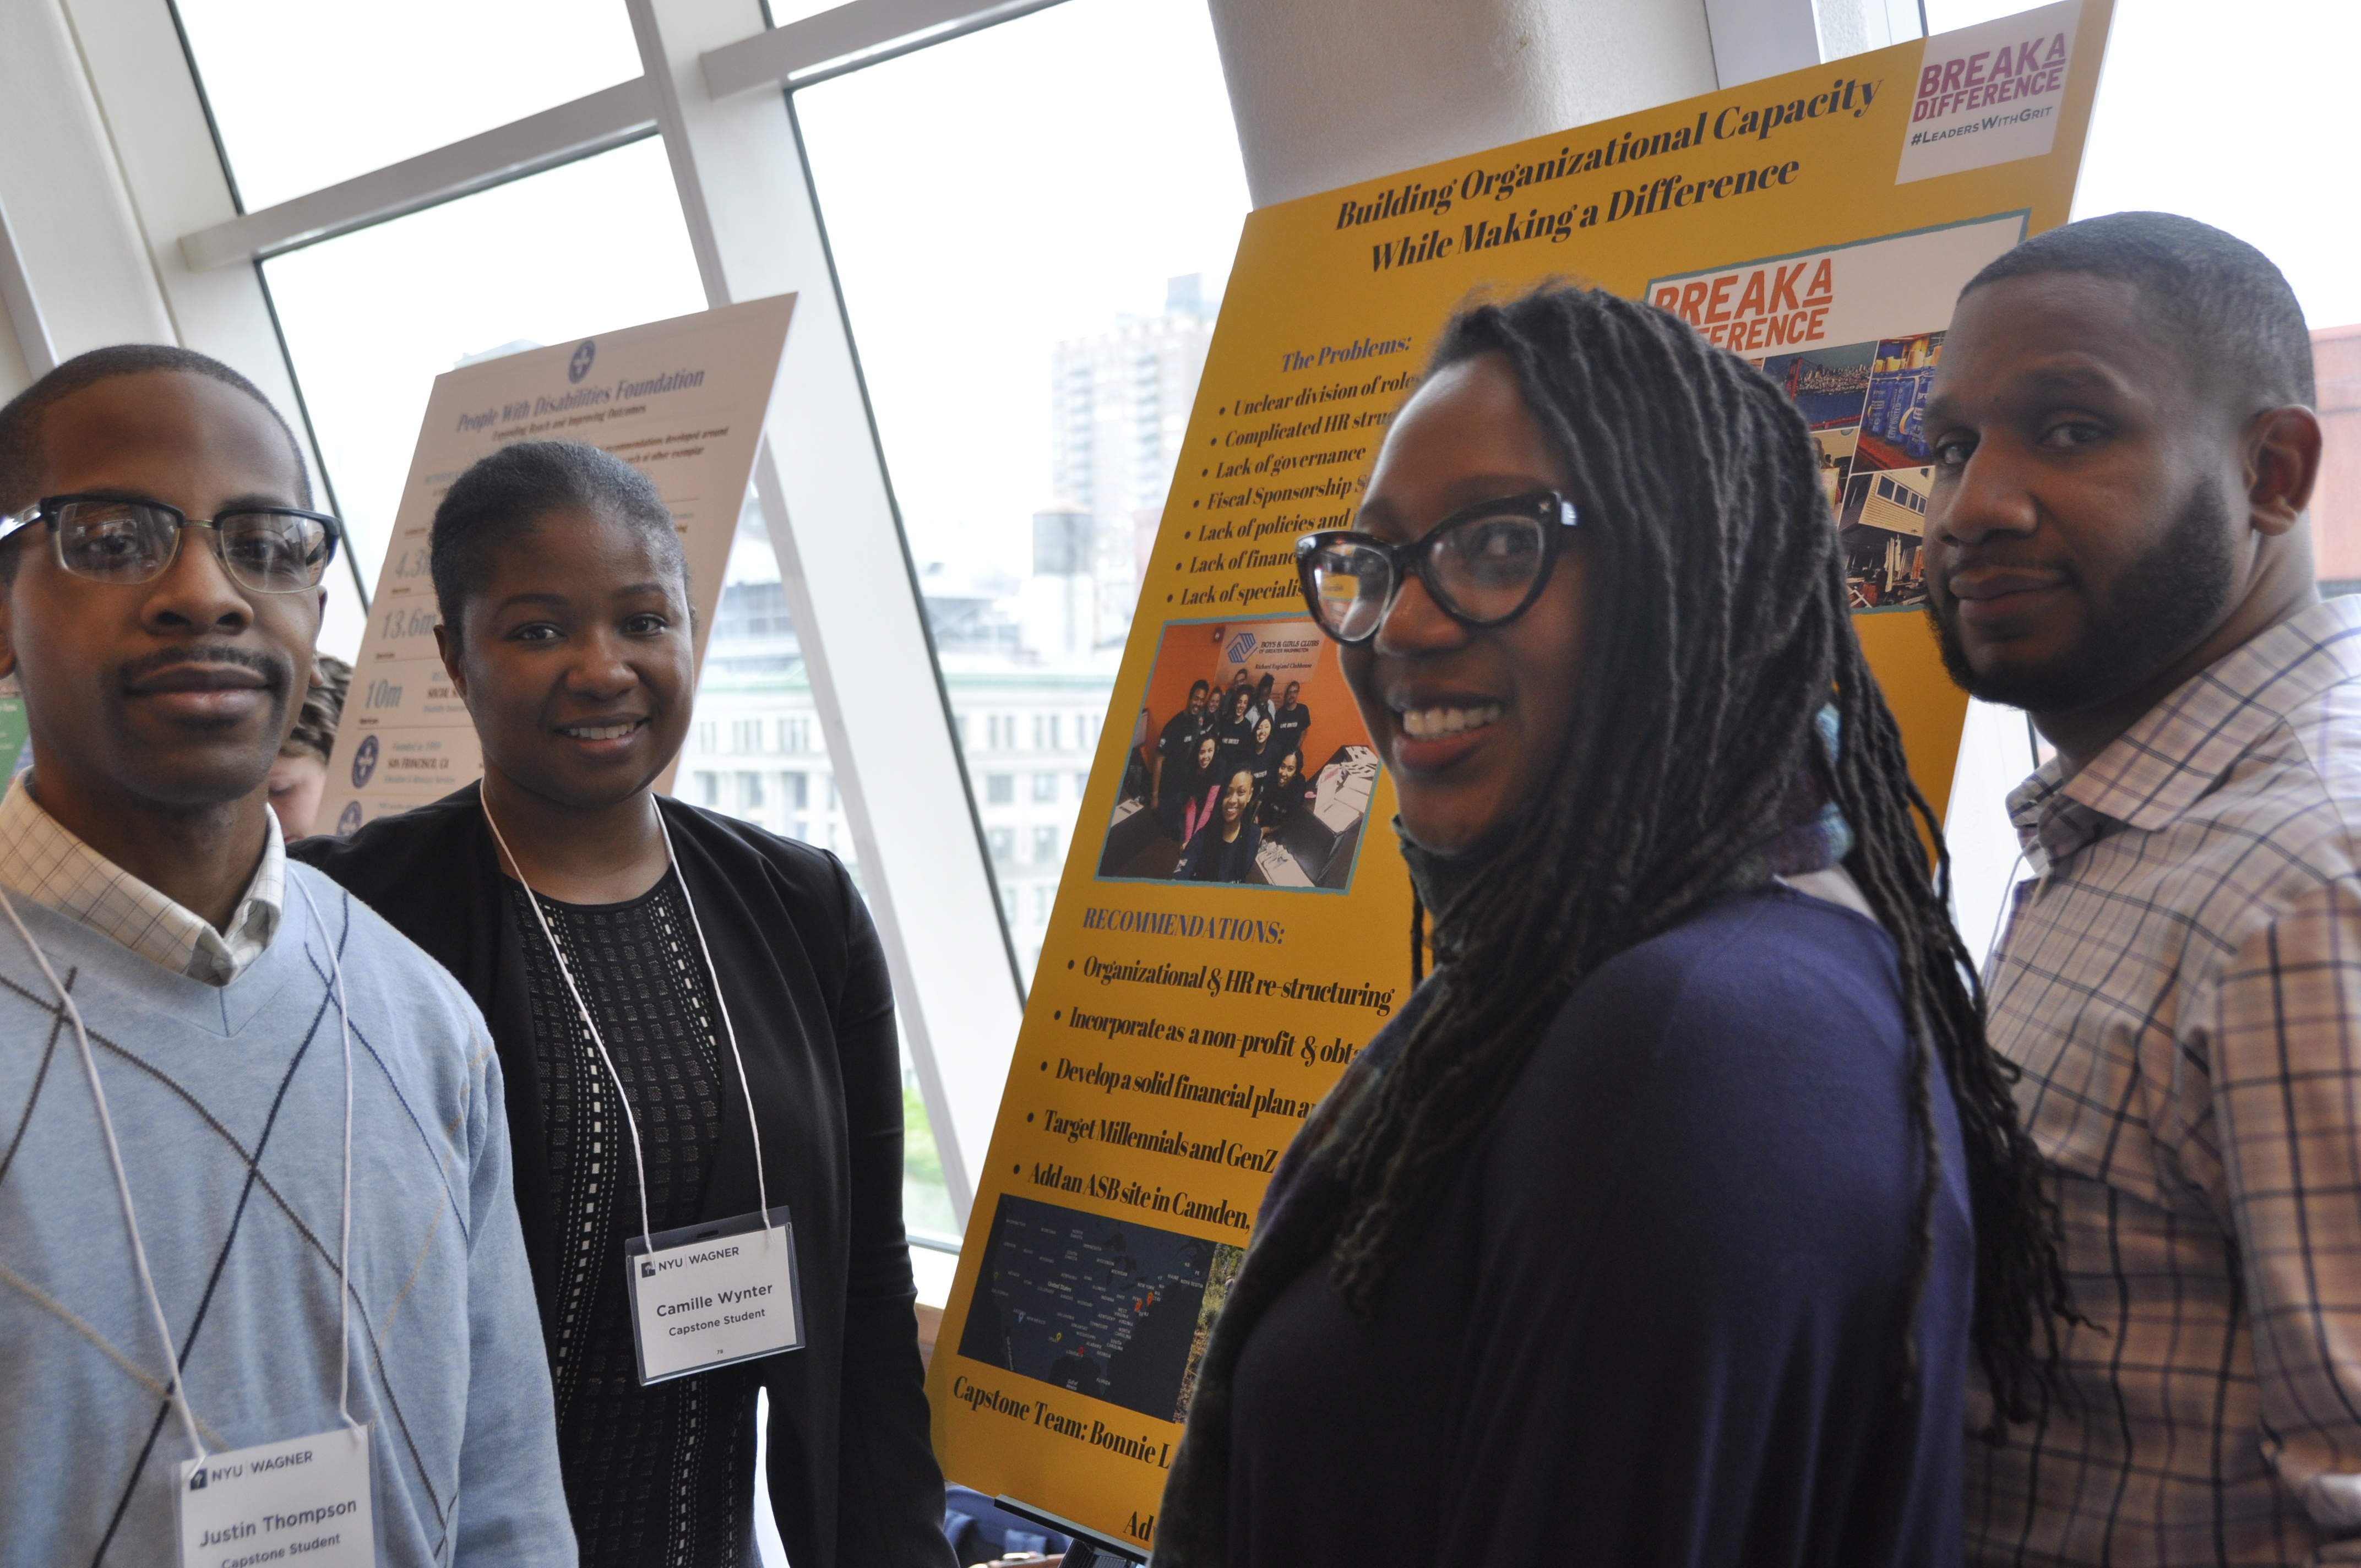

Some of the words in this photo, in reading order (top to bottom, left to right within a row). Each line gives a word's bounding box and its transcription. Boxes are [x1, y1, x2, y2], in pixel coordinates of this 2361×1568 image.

[1912, 67, 2064, 122] DIFFERENCE
[1335, 178, 1457, 230] Building
[1460, 112, 1708, 202] Organizational
[1713, 79, 1884, 141] Capacity
[1372, 230, 1453, 273] While
[1456, 204, 1578, 243] Making
[1579, 205, 1599, 228] a
[1604, 161, 1799, 223] Difference
[1281, 352, 1314, 372] The
[1318, 337, 1412, 366] Problems:
[456, 409, 499, 433] People
[502, 400, 532, 423] With
[533, 385, 611, 417] Disabilities
[615, 369, 706, 402] Foundation
[1234, 394, 1293, 417] Unclear
[1295, 383, 1358, 407] division
[1361, 376, 1381, 396] of
[1380, 372, 1416, 393] role
[1225, 417, 1321, 448] Complicated
[1324, 413, 1350, 432] HR
[1352, 411, 1391, 430] stru
[1215, 458, 1252, 478] Lack
[1254, 454, 1275, 473] of
[1271, 448, 1366, 476] governance
[1206, 488, 1252, 511] Fiscal
[1253, 476, 1352, 509] Sponsorship
[1198, 520, 1234, 542] Lack
[1236, 519, 1256, 537] of
[1254, 514, 1315, 541] policies
[1314, 508, 1351, 528] and
[1189, 552, 1226, 574] Lack
[1228, 550, 1248, 569] of
[1245, 549, 1297, 569] financ
[1180, 584, 1217, 606] Lack
[1219, 582, 1240, 602] of
[366, 679, 404, 709] 10m
[1082, 907, 1285, 945] RECOMMENDATIONS:
[1083, 955, 1207, 989] Organizational
[1206, 967, 1223, 997] &
[1225, 969, 1255, 994] HR
[1255, 973, 1395, 1017] re-structuring
[1068, 1007, 1165, 1041] Incorporate
[1165, 1022, 1185, 1043] as
[1188, 1026, 1199, 1045] a
[1198, 1029, 1297, 1058] non-profit
[1300, 1036, 1318, 1068] &
[1055, 1058, 1120, 1096] Develop
[1120, 1073, 1131, 1091] a
[1132, 1070, 1174, 1098] solid
[1172, 1074, 1255, 1110] financial
[1251, 1088, 1296, 1119] plan
[1043, 1109, 1096, 1144] Target
[1095, 1118, 1188, 1158] Millennials
[1188, 1138, 1225, 1163] and
[1226, 1143, 1279, 1174] GenZ
[1027, 1162, 1061, 1186] Add
[1061, 1174, 1081, 1193] an
[1082, 1174, 1120, 1201] ASB
[1119, 1184, 1151, 1209] site
[1151, 1188, 1171, 1212] in
[1172, 1191, 1251, 1234] Camden,
[659, 1258, 683, 1271] NYU
[688, 1246, 739, 1265] WAGNER
[657, 1296, 713, 1317] Camille
[717, 1283, 773, 1304] Wynter
[668, 1319, 720, 1336] Capstone
[723, 1308, 766, 1325] Student
[953, 1375, 1030, 1422] Capstone
[1034, 1401, 1087, 1441] Team:
[1087, 1420, 1156, 1464] Bonnie
[211, 1464, 243, 1482] NYU
[251, 1451, 313, 1473] WAGNER
[199, 1521, 257, 1548] Justin
[263, 1500, 357, 1533] Thompson
[221, 1547, 285, 1568] Capstone
[289, 1533, 341, 1555] Student
